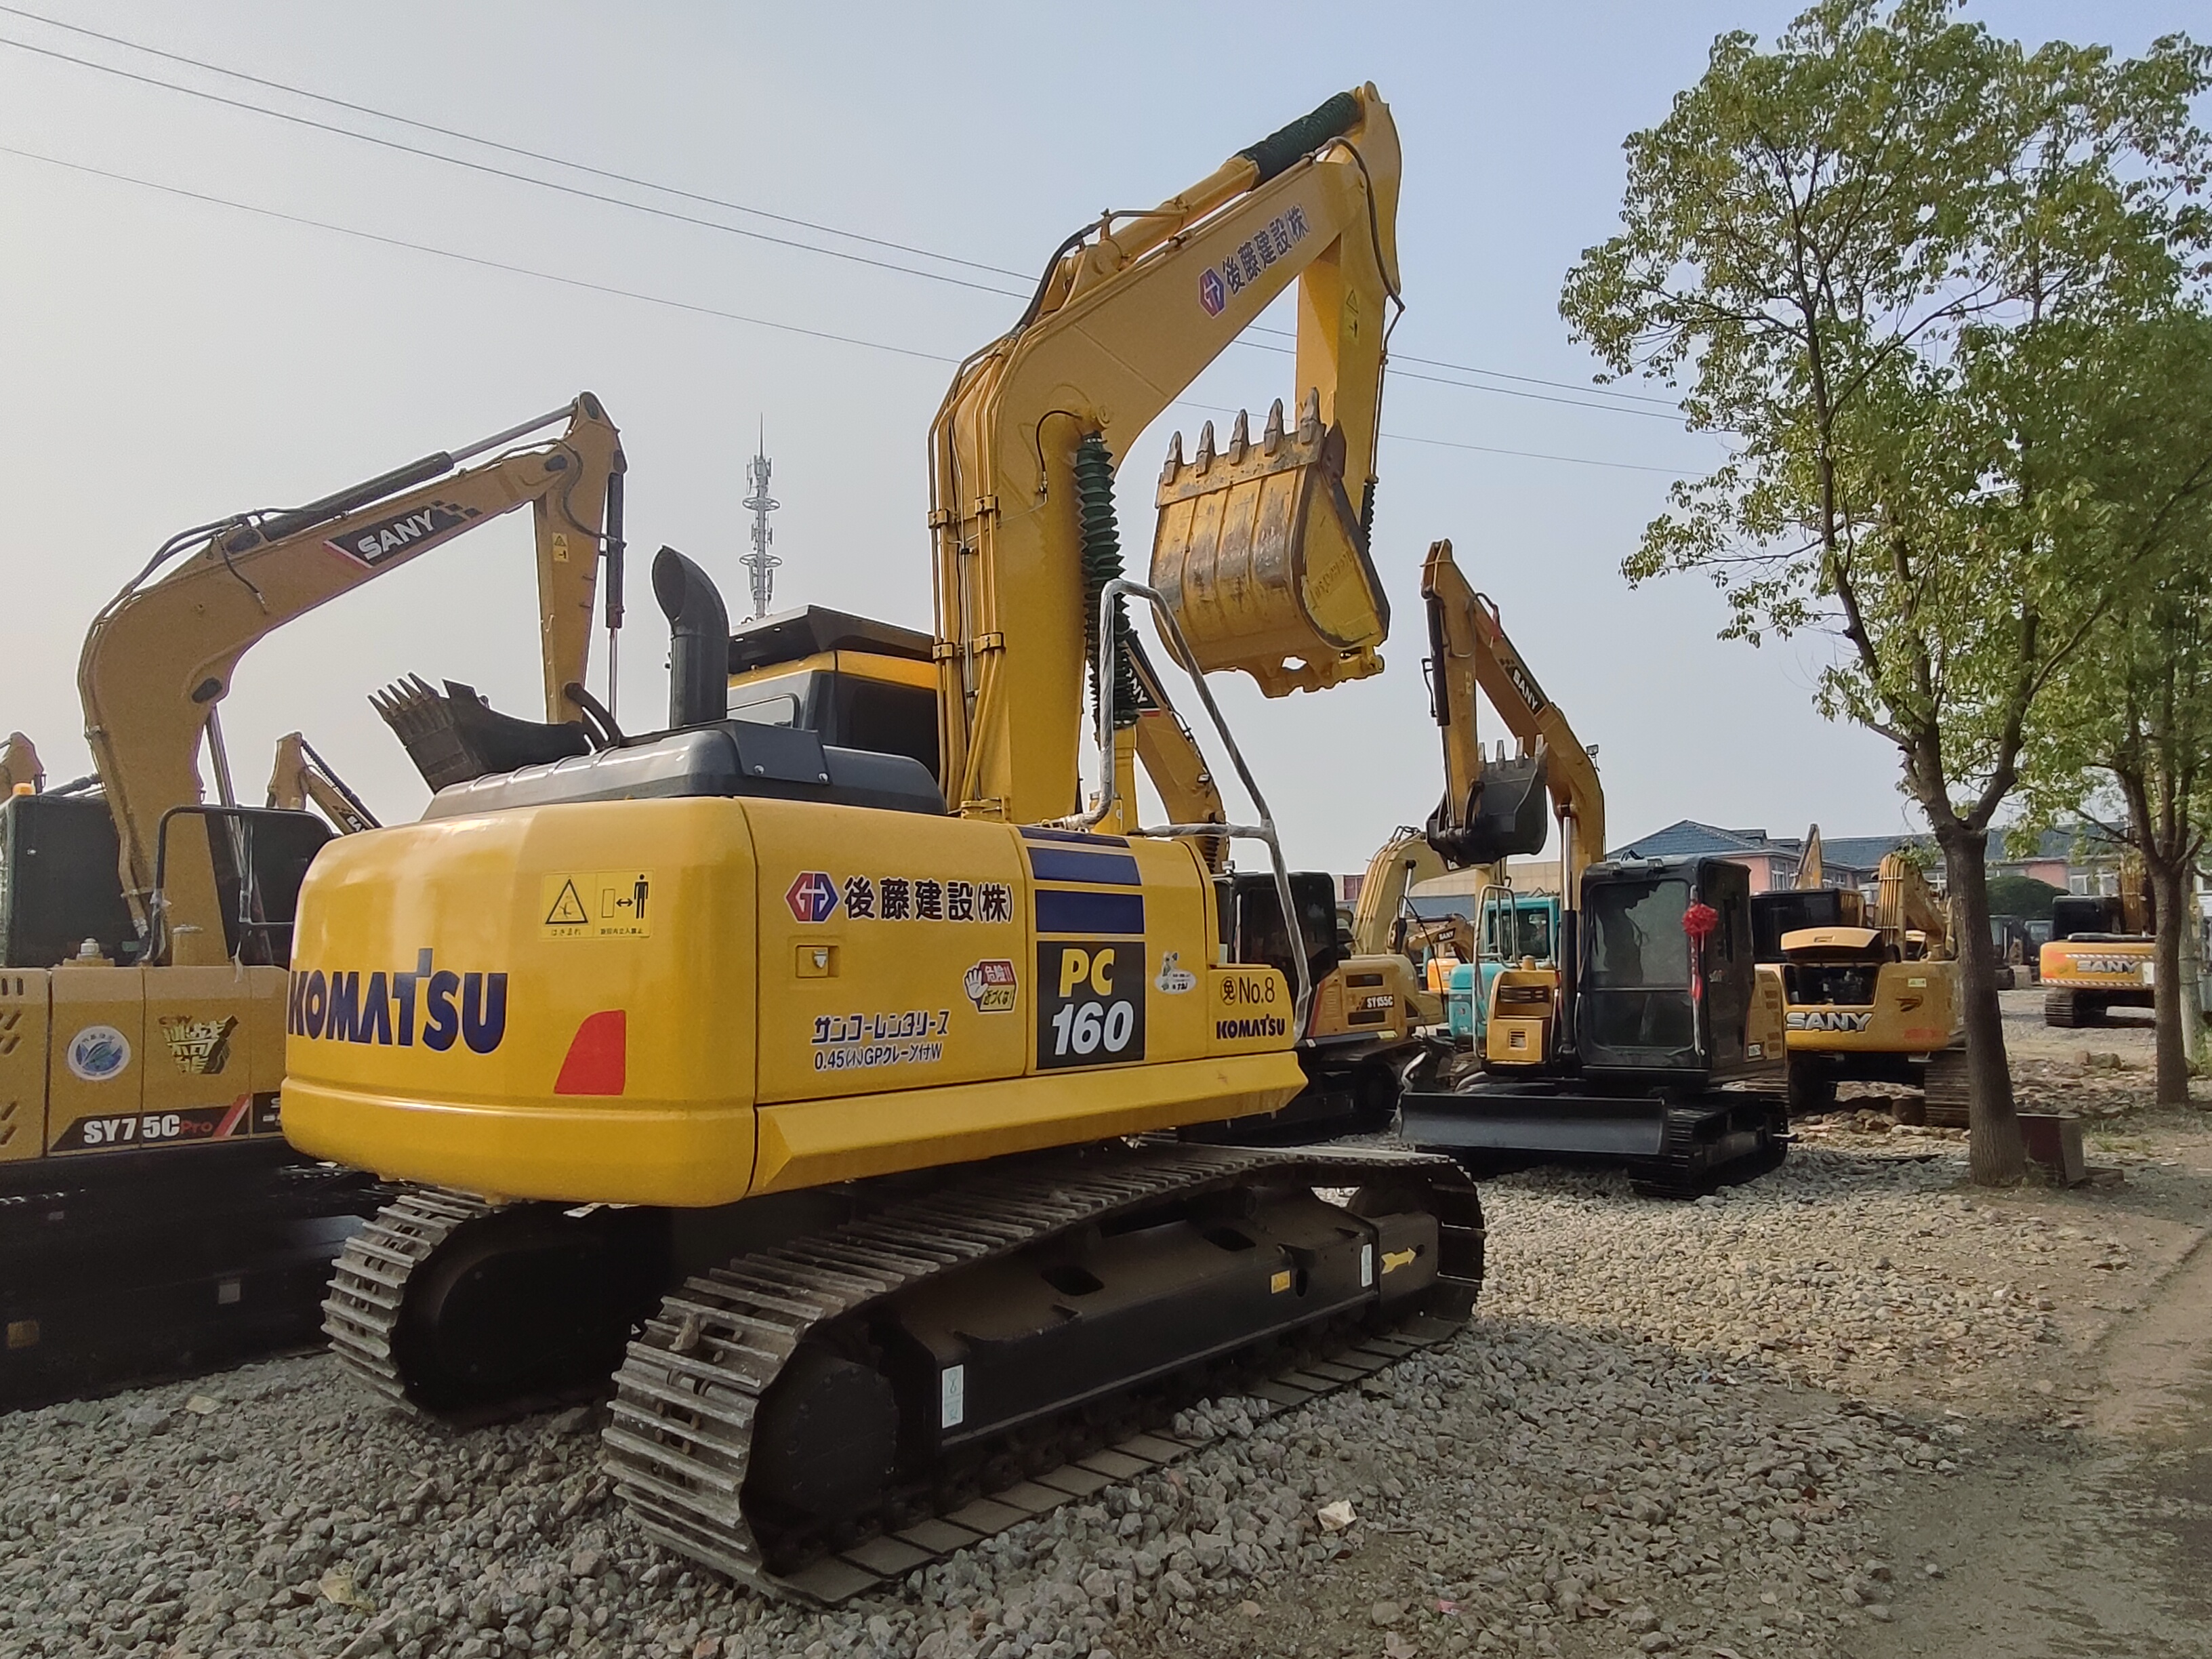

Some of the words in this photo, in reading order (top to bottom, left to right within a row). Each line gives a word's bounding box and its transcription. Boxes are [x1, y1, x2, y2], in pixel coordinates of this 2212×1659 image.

[358, 509, 434, 560] SANY
[1513, 669, 1538, 710] SANY
[1059, 948, 1115, 998] PC
[2076, 960, 2140, 974] SANY
[288, 947, 508, 1054] KOMATSU
[1786, 1012, 1872, 1031] SANY
[1052, 1000, 1134, 1056] 160
[1216, 1013, 1285, 1040] KOMATSU
